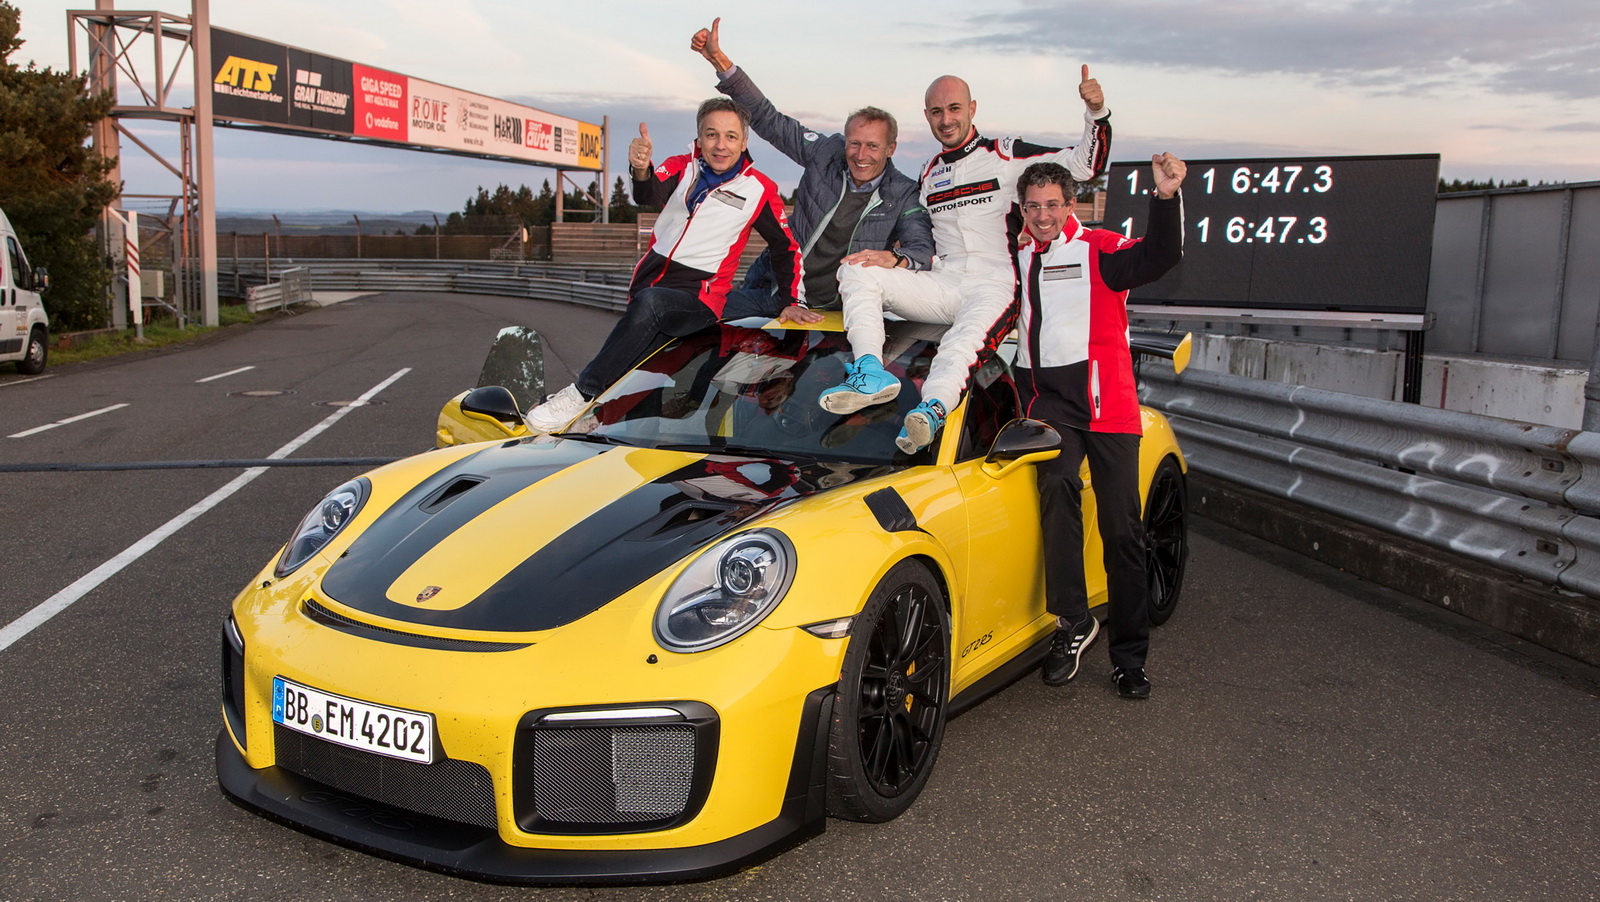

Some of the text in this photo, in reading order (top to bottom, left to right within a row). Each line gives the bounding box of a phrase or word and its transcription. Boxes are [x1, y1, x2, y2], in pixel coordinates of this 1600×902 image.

[214, 55, 278, 92] ATS
[294, 85, 348, 109] GRAN TURISMO
[361, 76, 402, 99] GIGA SPEED
[374, 116, 399, 131] vodafone
[412, 97, 448, 124] ROWE
[412, 119, 446, 132] MOTOR OIL
[494, 114, 512, 140] H&R
[527, 131, 552, 150] auto
[580, 132, 600, 159] ADAC
[1203, 168, 1215, 194] 1
[1231, 165, 1333, 194] 6:47.3
[1197, 216, 1210, 243] 1
[1226, 216, 1328, 244] 6:47.3
[286, 687, 425, 755] BB EM 4202
